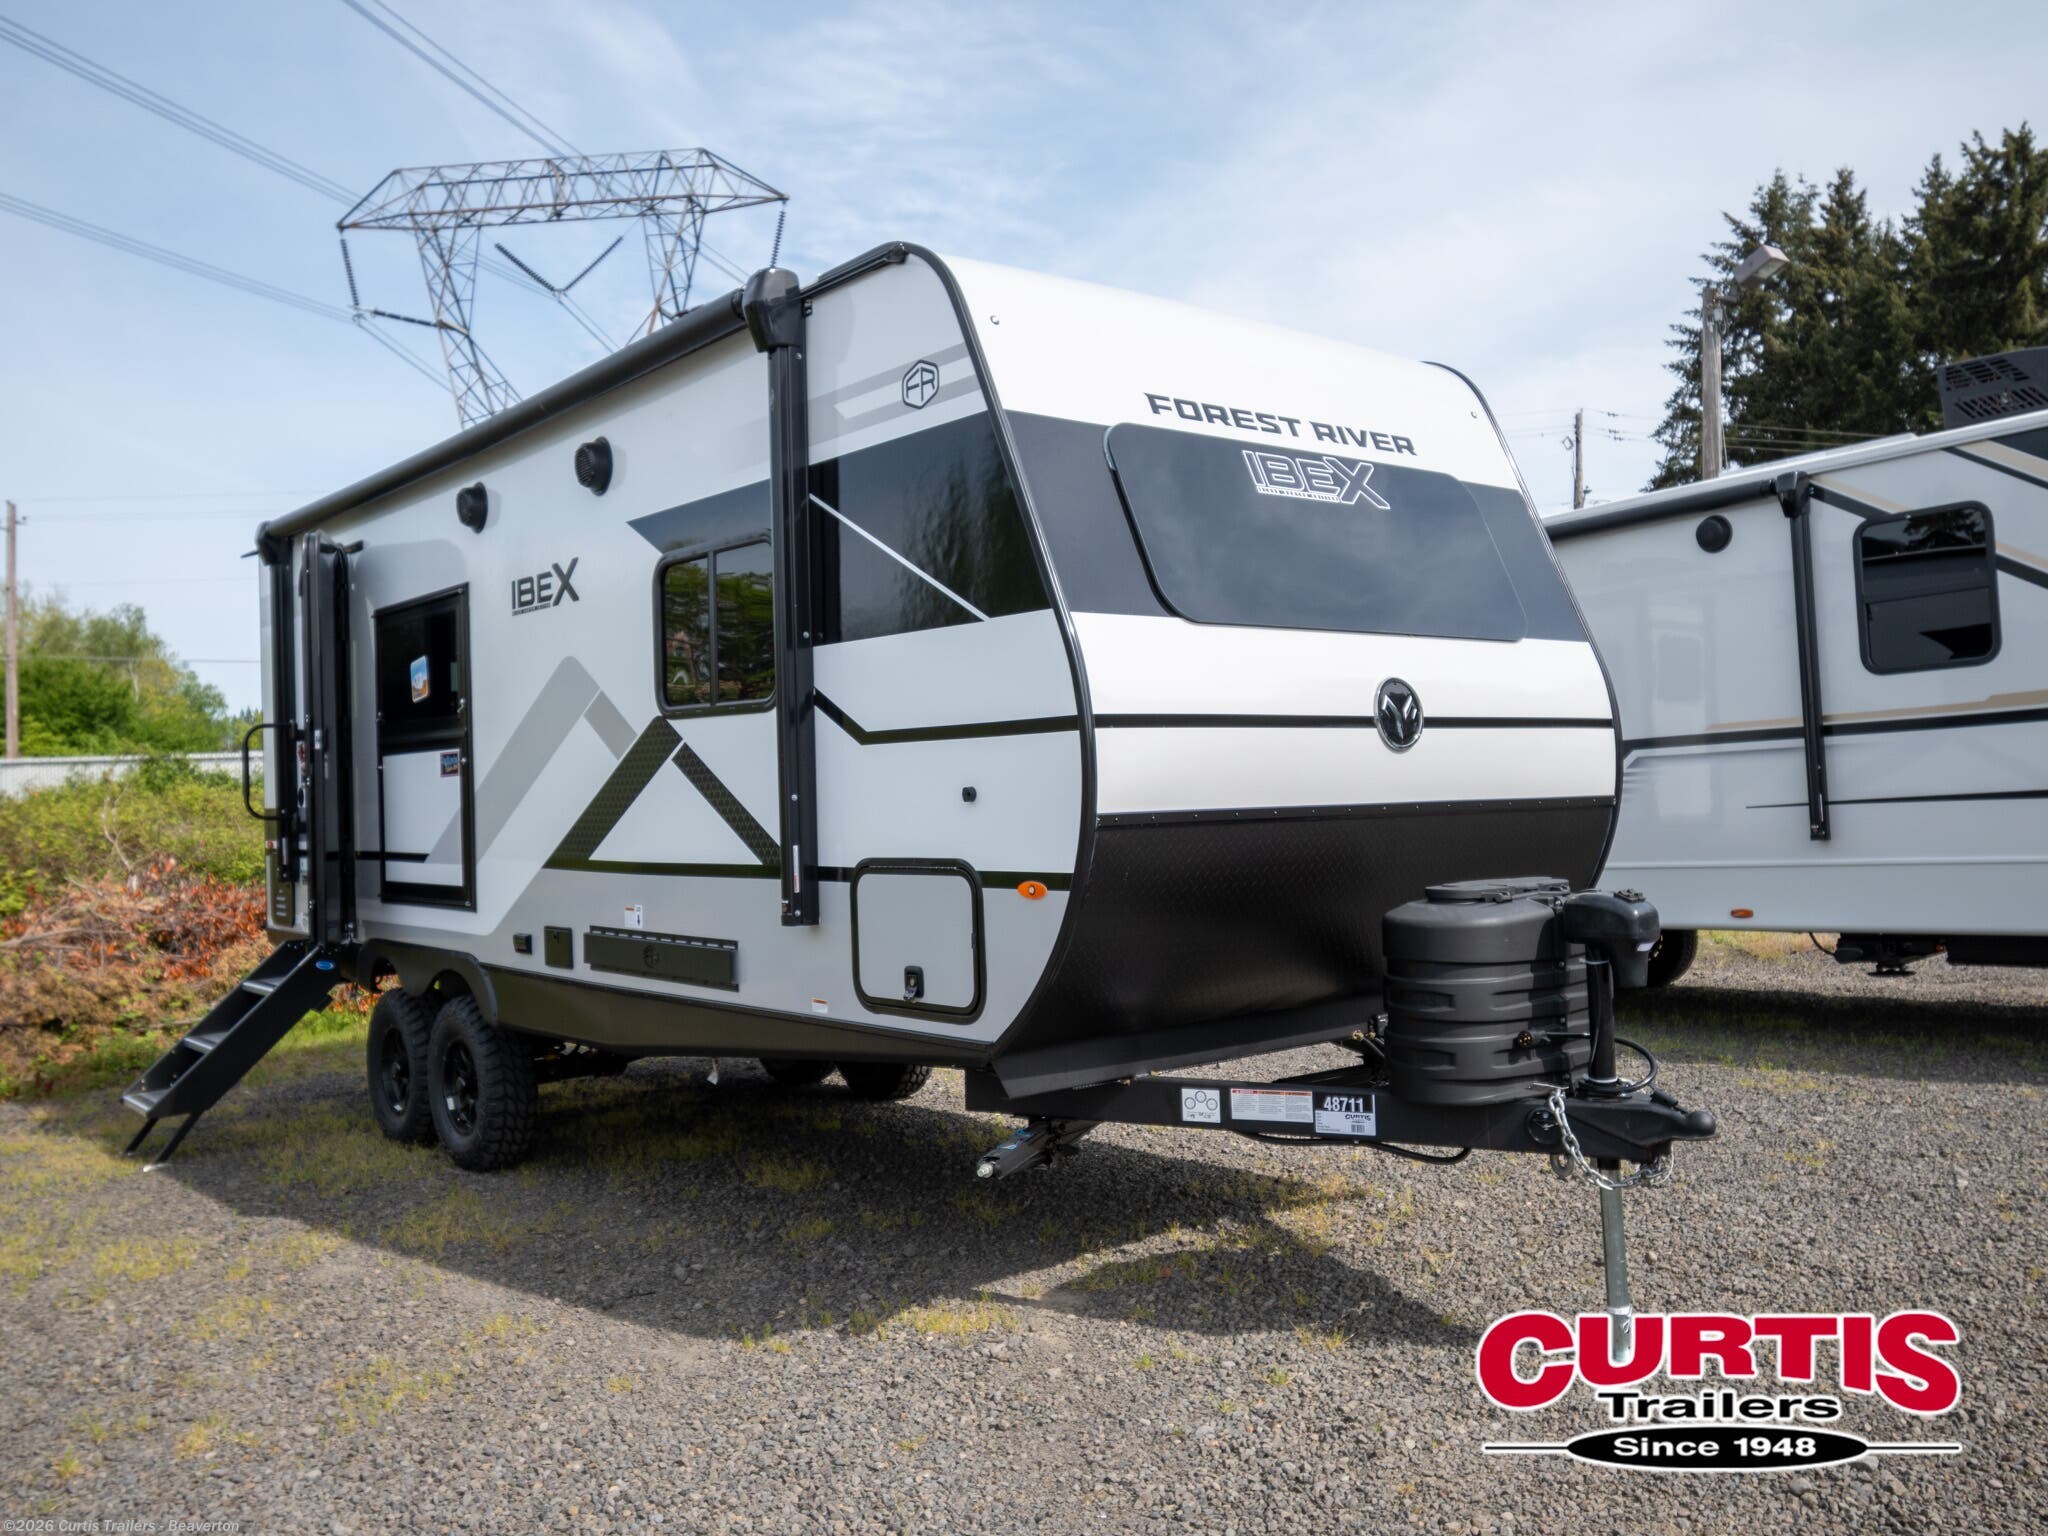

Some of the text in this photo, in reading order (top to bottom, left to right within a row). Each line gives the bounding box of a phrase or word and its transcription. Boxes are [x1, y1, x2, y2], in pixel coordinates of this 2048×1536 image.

[1144, 393, 1418, 456] FOREST RIVER
[1242, 449, 1391, 510] IBEX
[511, 556, 580, 610] IBEX
[1323, 1096, 1364, 1113] 48711
